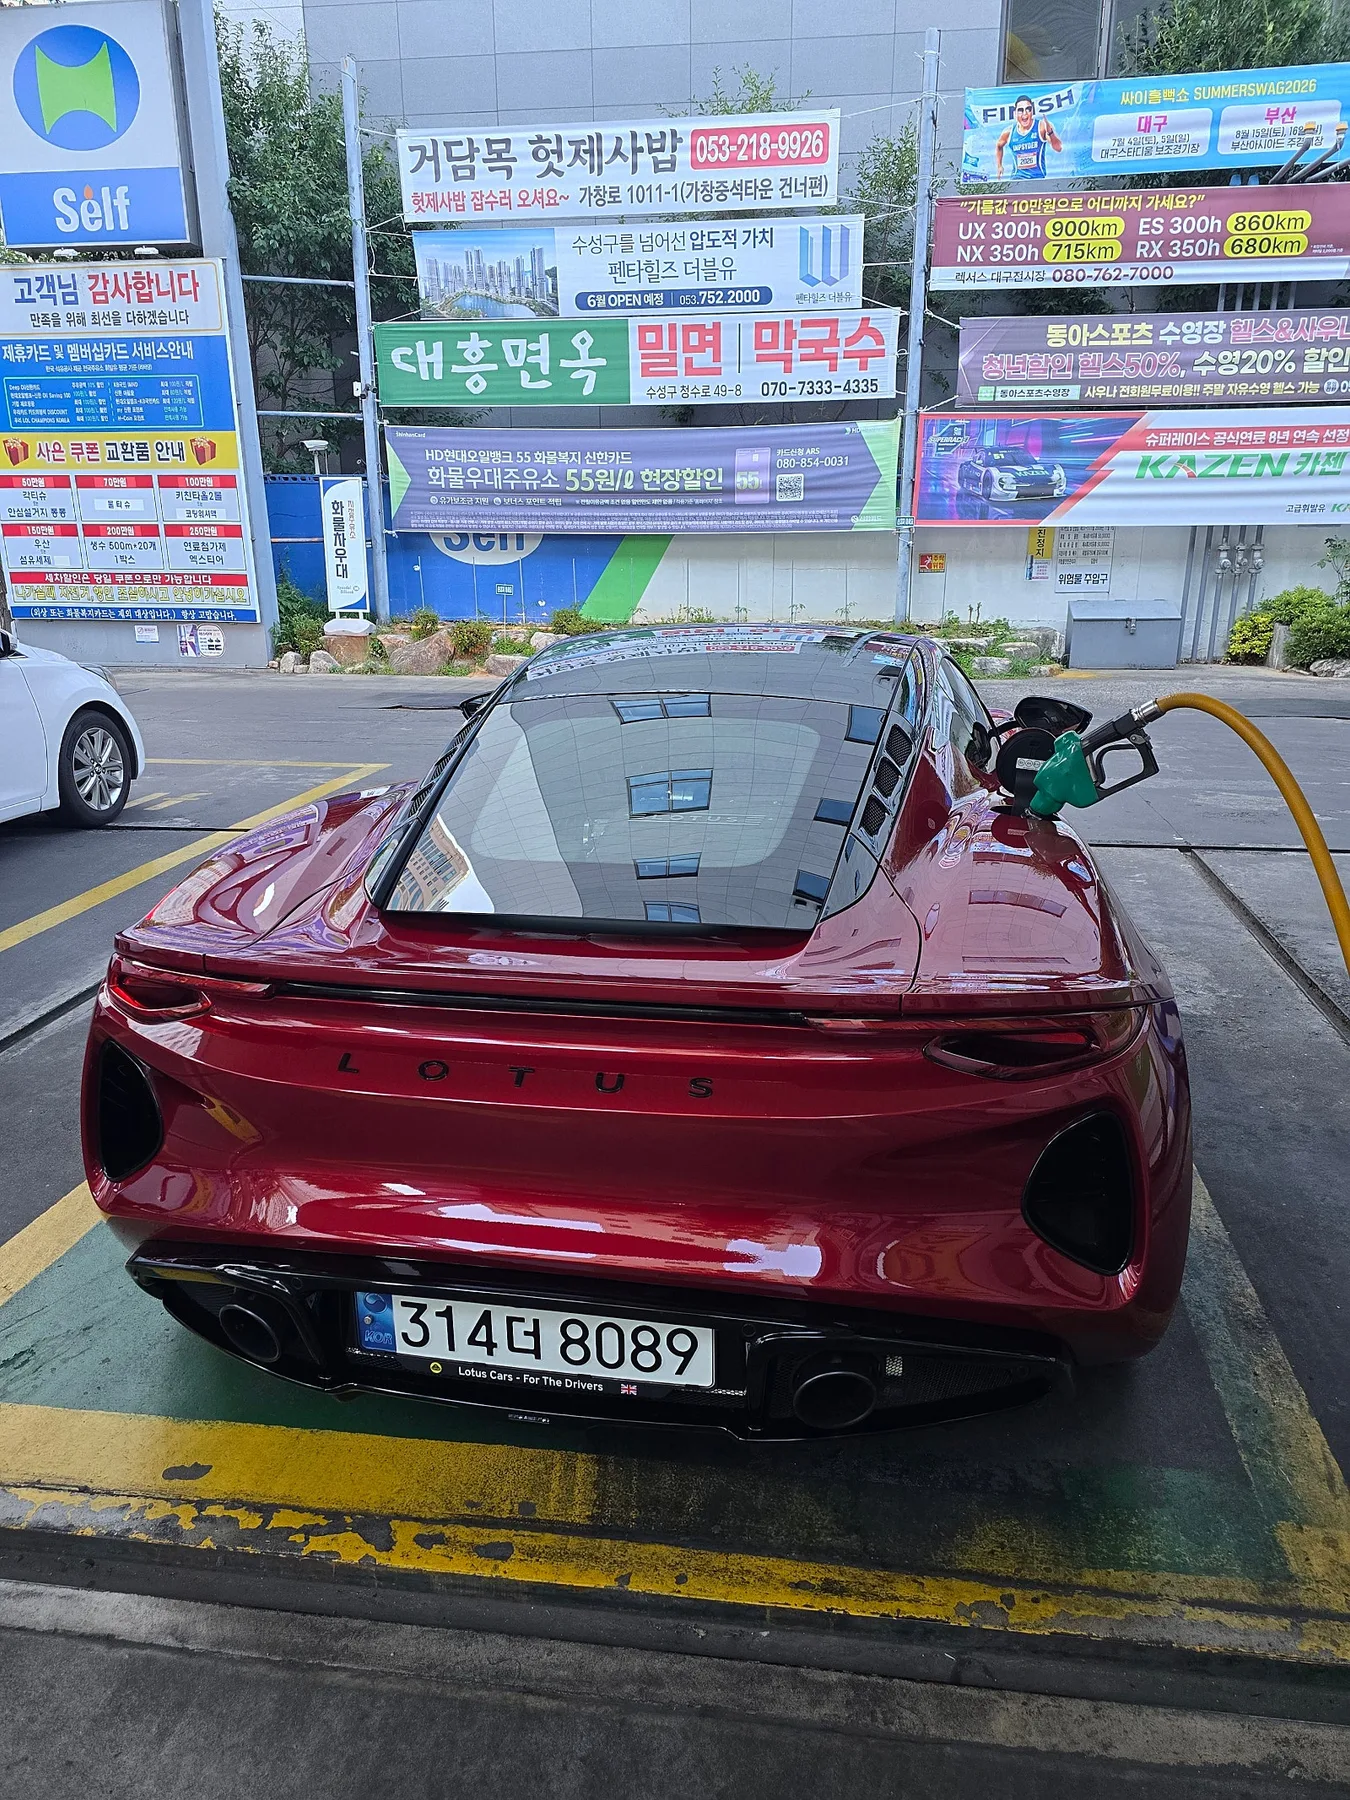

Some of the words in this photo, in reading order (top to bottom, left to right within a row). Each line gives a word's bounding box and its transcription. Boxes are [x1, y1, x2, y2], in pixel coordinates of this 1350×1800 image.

[1194, 79, 1318, 101] SUMMERSWAG2026
[1137, 115, 1168, 133] 대구
[1265, 107, 1297, 125] 부산
[1112, 138, 1125, 148] 7월
[1161, 133, 1190, 145] 5일(일)
[1235, 129, 1249, 140] 8월
[1101, 146, 1154, 160] 대구스타디움
[1155, 143, 1200, 157] 보조경기장
[1231, 139, 1285, 152] 부산아시아드
[407, 136, 518, 183] 거담목
[527, 127, 684, 180] 헛제사밥
[696, 129, 824, 164] 053-218-9926
[411, 190, 467, 213] 헛제사밥
[471, 189, 513, 211] 잡수러
[517, 187, 569, 209] 오셔요~
[579, 185, 622, 207] 가창로
[779, 174, 828, 200] 건너편)
[53, 184, 131, 233] Self
[1011, 198, 1083, 215] 10만원으로
[1087, 195, 1143, 212] 어디까지
[958, 222, 986, 240] UX
[991, 221, 1041, 240] 300h
[1052, 219, 1118, 237] 900km
[1138, 217, 1164, 236] ES
[1169, 215, 1222, 234] 300h
[1234, 213, 1305, 231] 860km
[572, 234, 635, 256] 수성구를
[639, 231, 687, 253] 넘어선
[689, 229, 738, 251] 압도적
[742, 227, 773, 249] 가치
[956, 245, 985, 262] NX
[989, 244, 1039, 262] 350h
[1051, 242, 1115, 260] 715km
[1136, 240, 1164, 258] RX
[1168, 238, 1221, 257] 350h
[1231, 236, 1301, 255] 680km
[608, 259, 679, 285] 펜타힐즈
[684, 256, 737, 282] 더블유
[955, 271, 987, 284] 렉서스
[991, 270, 1047, 283] 대구전시장
[1052, 266, 1175, 283] 080-762-7000
[13, 273, 80, 306] 고객님
[87, 269, 200, 305] 감사합니다
[587, 294, 606, 309] 6월
[607, 294, 641, 307] OPEN
[643, 292, 664, 306] 예정
[679, 289, 760, 306] 053.752.2000
[795, 293, 826, 305] 펜타힐즈
[828, 292, 853, 303] 더블유
[30, 312, 62, 328] 만족을
[66, 311, 86, 328] 위해
[91, 310, 122, 327] 최선을
[126, 309, 190, 326] 다하겠습니다
[1046, 322, 1154, 348] 동아스포츠
[1159, 320, 1227, 346] 수영장
[2, 343, 51, 362] 제휴카드
[53, 344, 64, 360] 및
[67, 342, 130, 362] 멤버십카드
[132, 341, 194, 360] 서비스안내
[390, 330, 608, 396] 대흥면옥
[638, 321, 722, 378] 밀면
[754, 316, 886, 374] 막국수
[982, 353, 1074, 381] 청년할인
[1192, 348, 1296, 377] 수영20%
[1303, 347, 1350, 374] 할인
[646, 384, 677, 400] 수성구
[680, 384, 711, 399] 청수로
[714, 383, 742, 397] 49-8
[761, 378, 879, 397] 070-7333-4335
[1000, 388, 1070, 399] 동아스포츠수영장
[1085, 385, 1117, 398] 사우나
[1203, 384, 1224, 397] 주말
[1227, 382, 1271, 396] 자유수영
[1273, 381, 1295, 395] 헬스
[1297, 381, 1320, 394] 가능
[1146, 432, 1210, 448] 슈퍼레이스
[1213, 431, 1267, 446] 공식연료
[1268, 430, 1289, 445] 8년
[1292, 429, 1320, 445] 연속
[1323, 428, 1350, 443] 선정
[37, 441, 66, 463] 사은
[70, 441, 100, 463] 쿠폰
[105, 441, 150, 463] 교환품
[155, 441, 185, 463] 안내
[425, 449, 513, 464] HD현대오일뱅크
[516, 451, 531, 463] 55
[534, 451, 581, 465] 화물복지
[584, 451, 633, 465] 신한카드
[777, 448, 805, 456] 카드신청
[776, 456, 849, 469] 080-854-0031
[1135, 452, 1290, 479] KAZEN
[1293, 451, 1348, 476] 카젠
[22, 477, 46, 488] 50만원
[104, 477, 127, 488] 70만원
[185, 476, 213, 488] 100만원
[428, 466, 560, 490] 화물우대주유소
[640, 467, 723, 492] 현장할인
[22, 491, 47, 501] 각티슈
[440, 497, 474, 507] 유가보조금
[475, 497, 489, 507] 지원
[526, 498, 546, 507] 포인트
[548, 498, 562, 508] 적립
[1286, 503, 1326, 514] 고급휘발유
[27, 525, 55, 536] 150만원
[107, 525, 134, 536] 200만원
[332, 500, 348, 579] 화물차우대
[34, 539, 50, 549] 우산
[90, 541, 106, 551] 생수
[184, 542, 226, 552] 연료첨가제
[20, 555, 51, 566] 섬유세제
[114, 555, 136, 565] 1박스
[45, 573, 90, 584] 세차할인은
[93, 574, 112, 584] 당일
[115, 574, 161, 585] 쿠폰으로만
[165, 574, 212, 585] 가능합니다
[1058, 573, 1082, 585] 위험물
[1084, 573, 1108, 585] 주입구
[118, 586, 170, 602] 조심하시고
[173, 586, 247, 603] 안녕히가십시오
[50, 608, 64, 618] 또는
[337, 1052, 714, 1099] LOTUS
[365, 1330, 393, 1345] KOR
[399, 1300, 543, 1361] 314더
[559, 1318, 699, 1377] 8089
[458, 1366, 487, 1380] Lotus
[489, 1370, 514, 1382] Cars
[523, 1374, 540, 1385] For
[542, 1376, 563, 1387] The
[565, 1379, 604, 1391] Drivers
